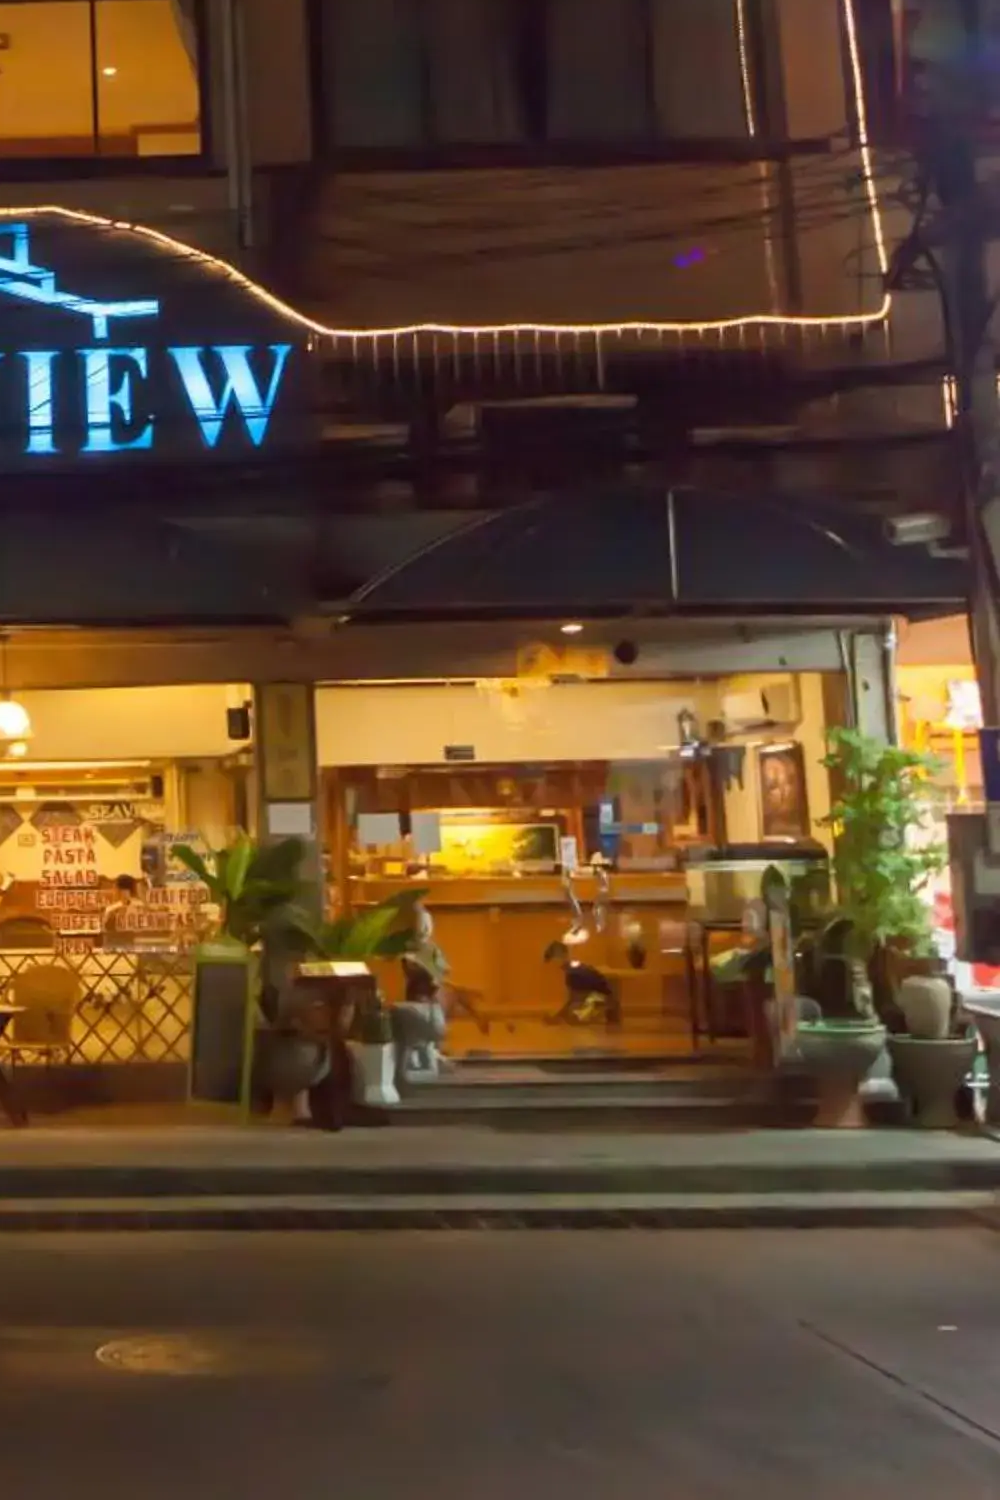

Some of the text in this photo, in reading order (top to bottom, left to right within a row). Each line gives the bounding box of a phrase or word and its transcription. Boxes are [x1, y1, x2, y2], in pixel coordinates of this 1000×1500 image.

[41, 827, 95, 843] STEAK
[43, 848, 96, 864] PASTA
[40, 870, 97, 886] SALAD
